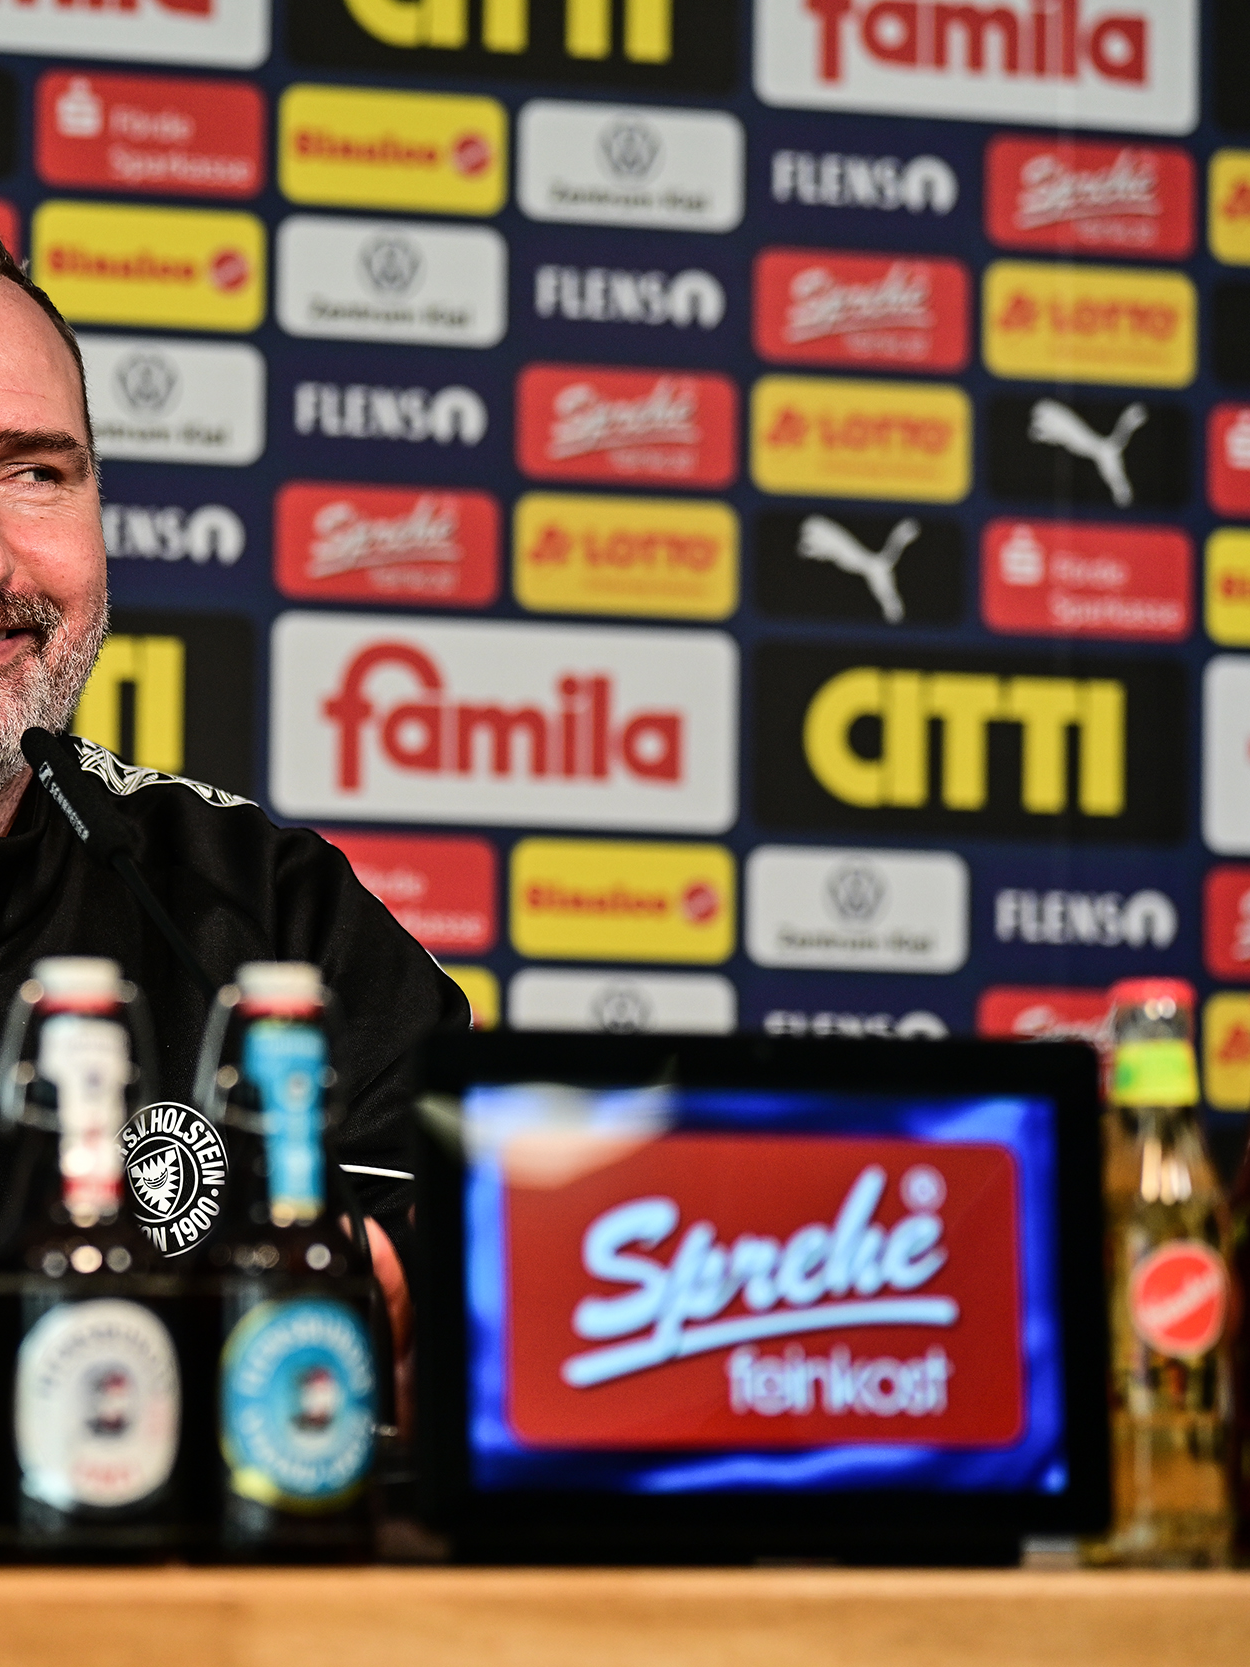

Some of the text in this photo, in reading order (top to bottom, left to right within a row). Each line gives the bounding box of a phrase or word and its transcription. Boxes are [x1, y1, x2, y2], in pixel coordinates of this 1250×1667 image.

[101, 503, 188, 562] ENS
[321, 640, 685, 796] famila
[802, 666, 1127, 817] CITTI
[169, 1196, 220, 1247] 1900
[572, 1163, 948, 1357] Sprehe
[726, 1342, 954, 1418] feinkost
